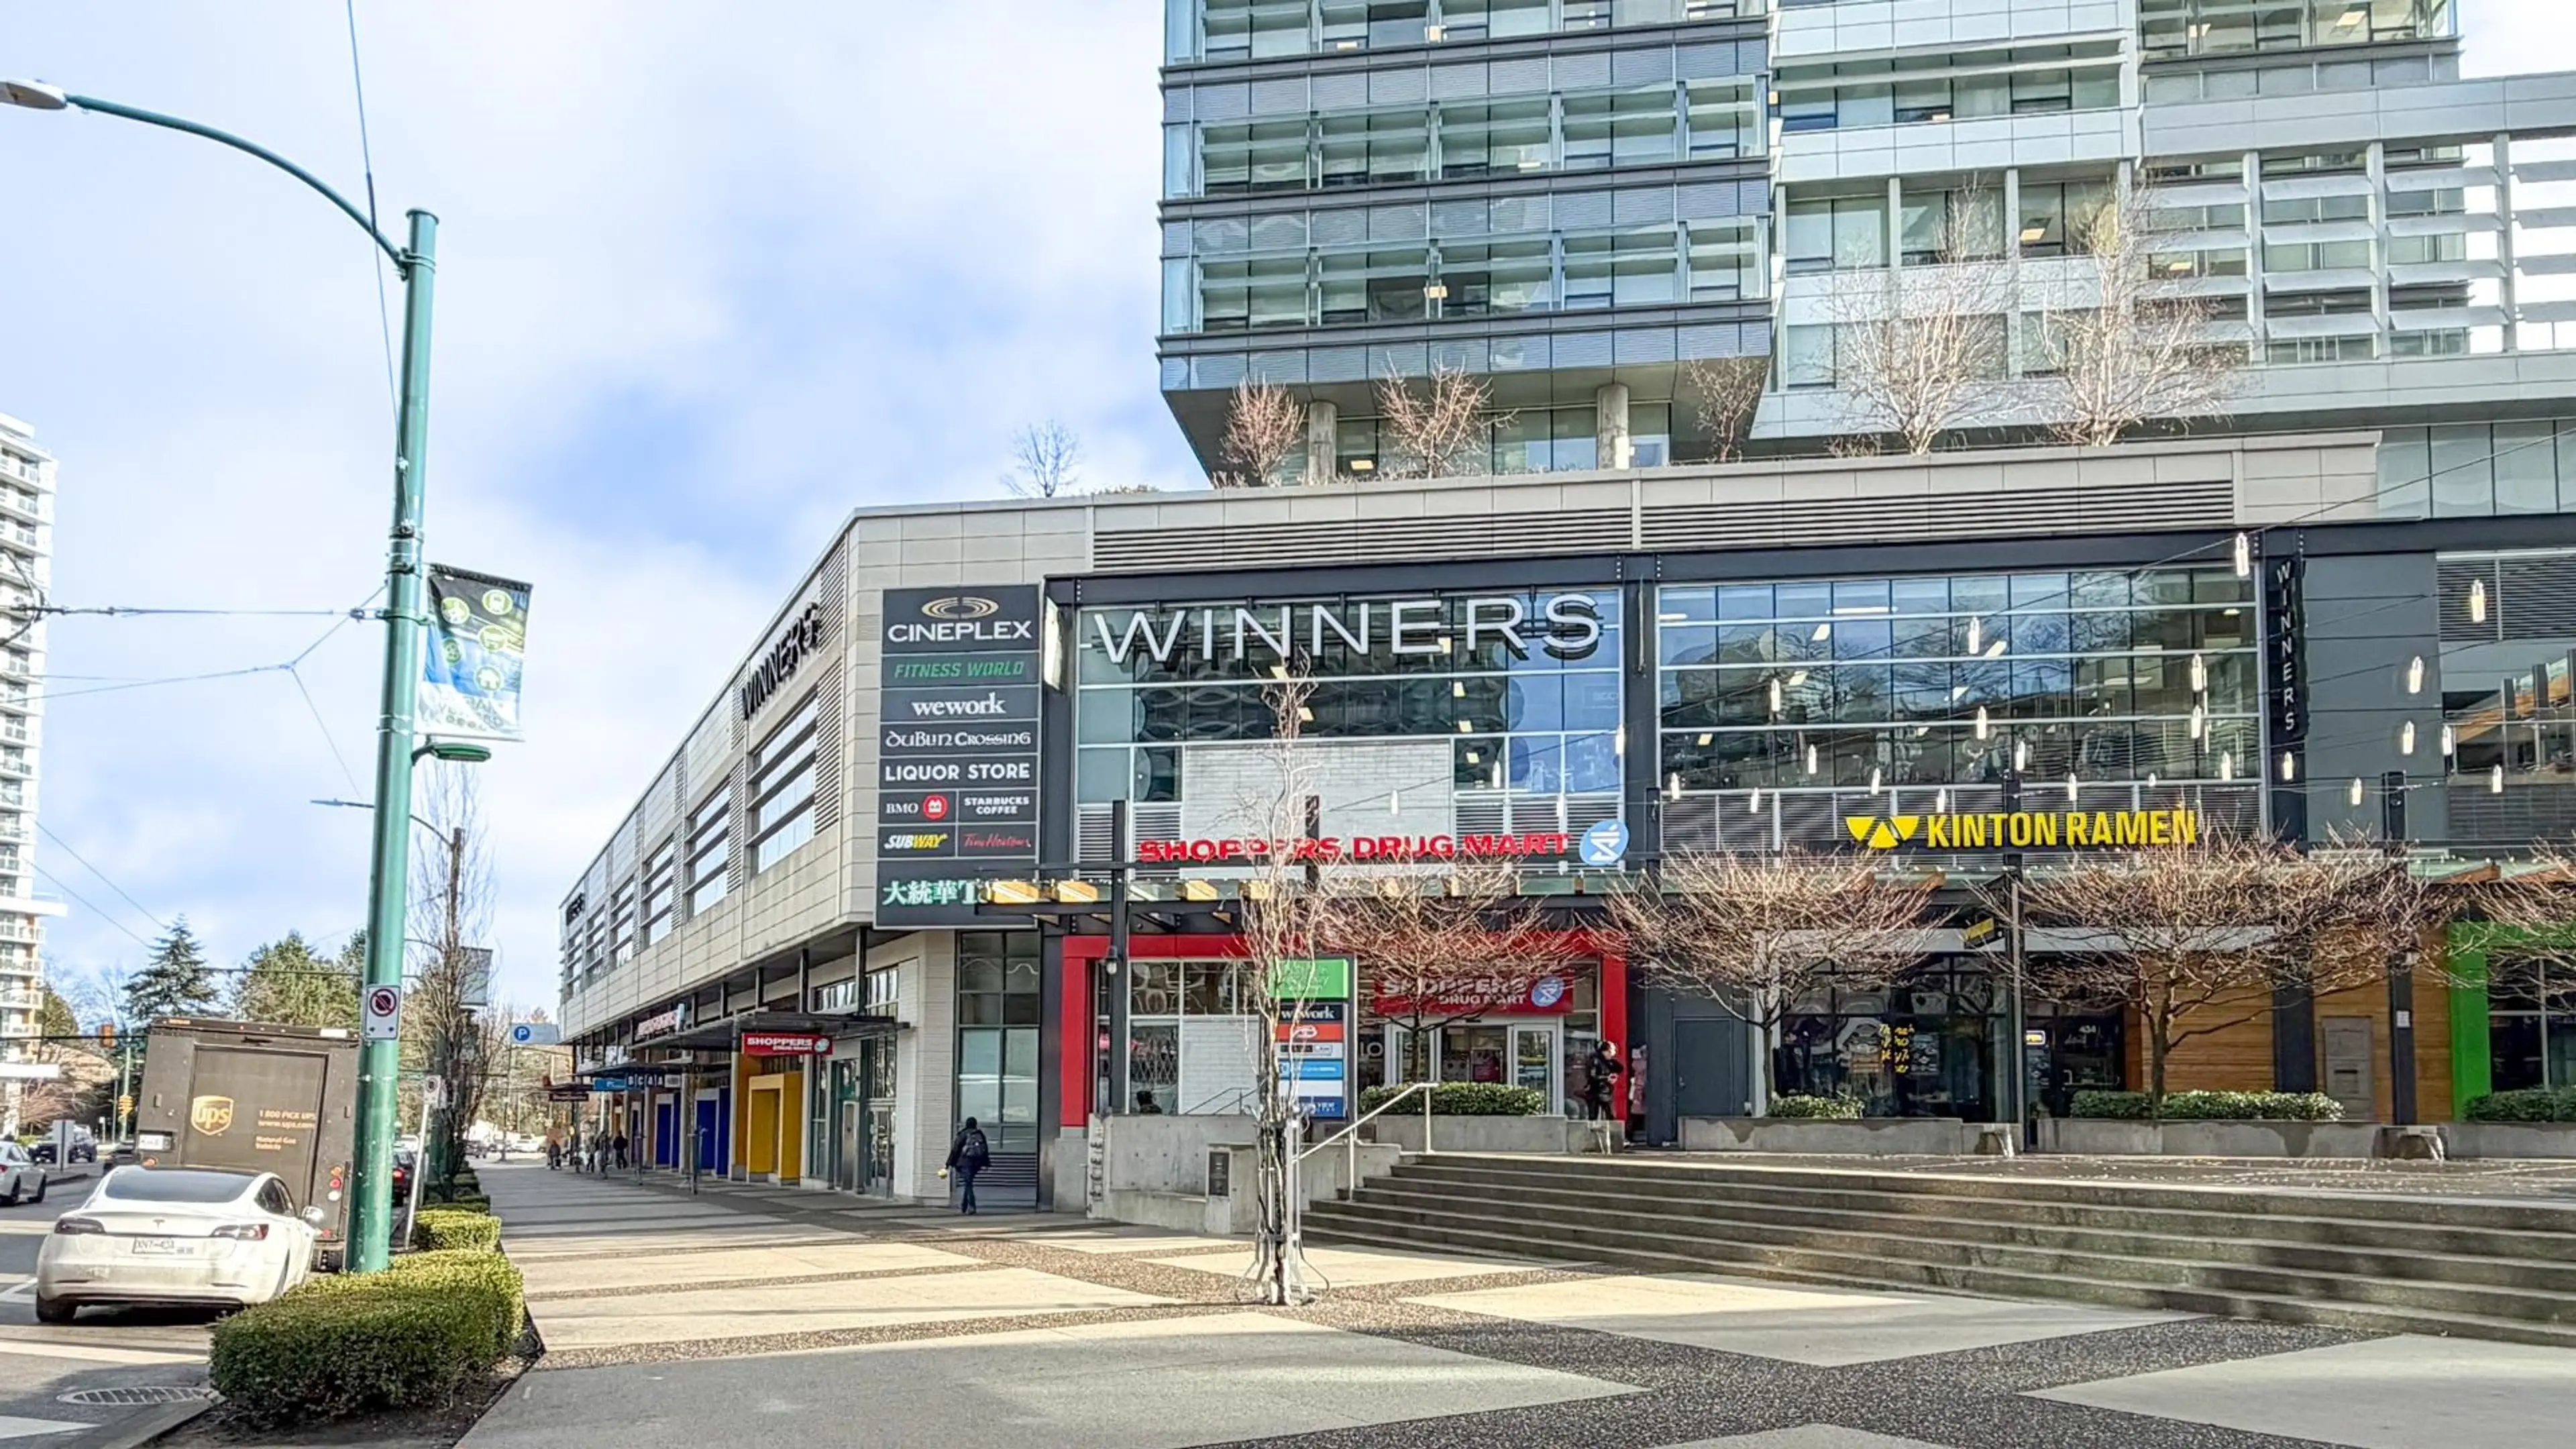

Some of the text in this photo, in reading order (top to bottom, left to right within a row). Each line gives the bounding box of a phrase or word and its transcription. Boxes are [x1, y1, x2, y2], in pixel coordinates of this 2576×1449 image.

[888, 621, 1032, 642] CINEPLEX
[1093, 594, 1600, 663] WINNERS
[2277, 561, 2295, 731] WINNERS
[894, 661, 1024, 679] FITNESS WORLD
[912, 692, 1006, 716] wework
[885, 763, 1030, 782] LIQUOR STORE
[885, 802, 919, 814] BMO
[964, 796, 1030, 806] STARBUCKS
[975, 806, 1018, 815] COFFEE
[1927, 810, 2196, 847] KINTON RAMEN
[883, 833, 948, 849] SUBWAY
[1138, 833, 1571, 862] SHOPPRS DRUG MART
[747, 1037, 813, 1046] SHOPPERS
[195, 1107, 229, 1130] ups
